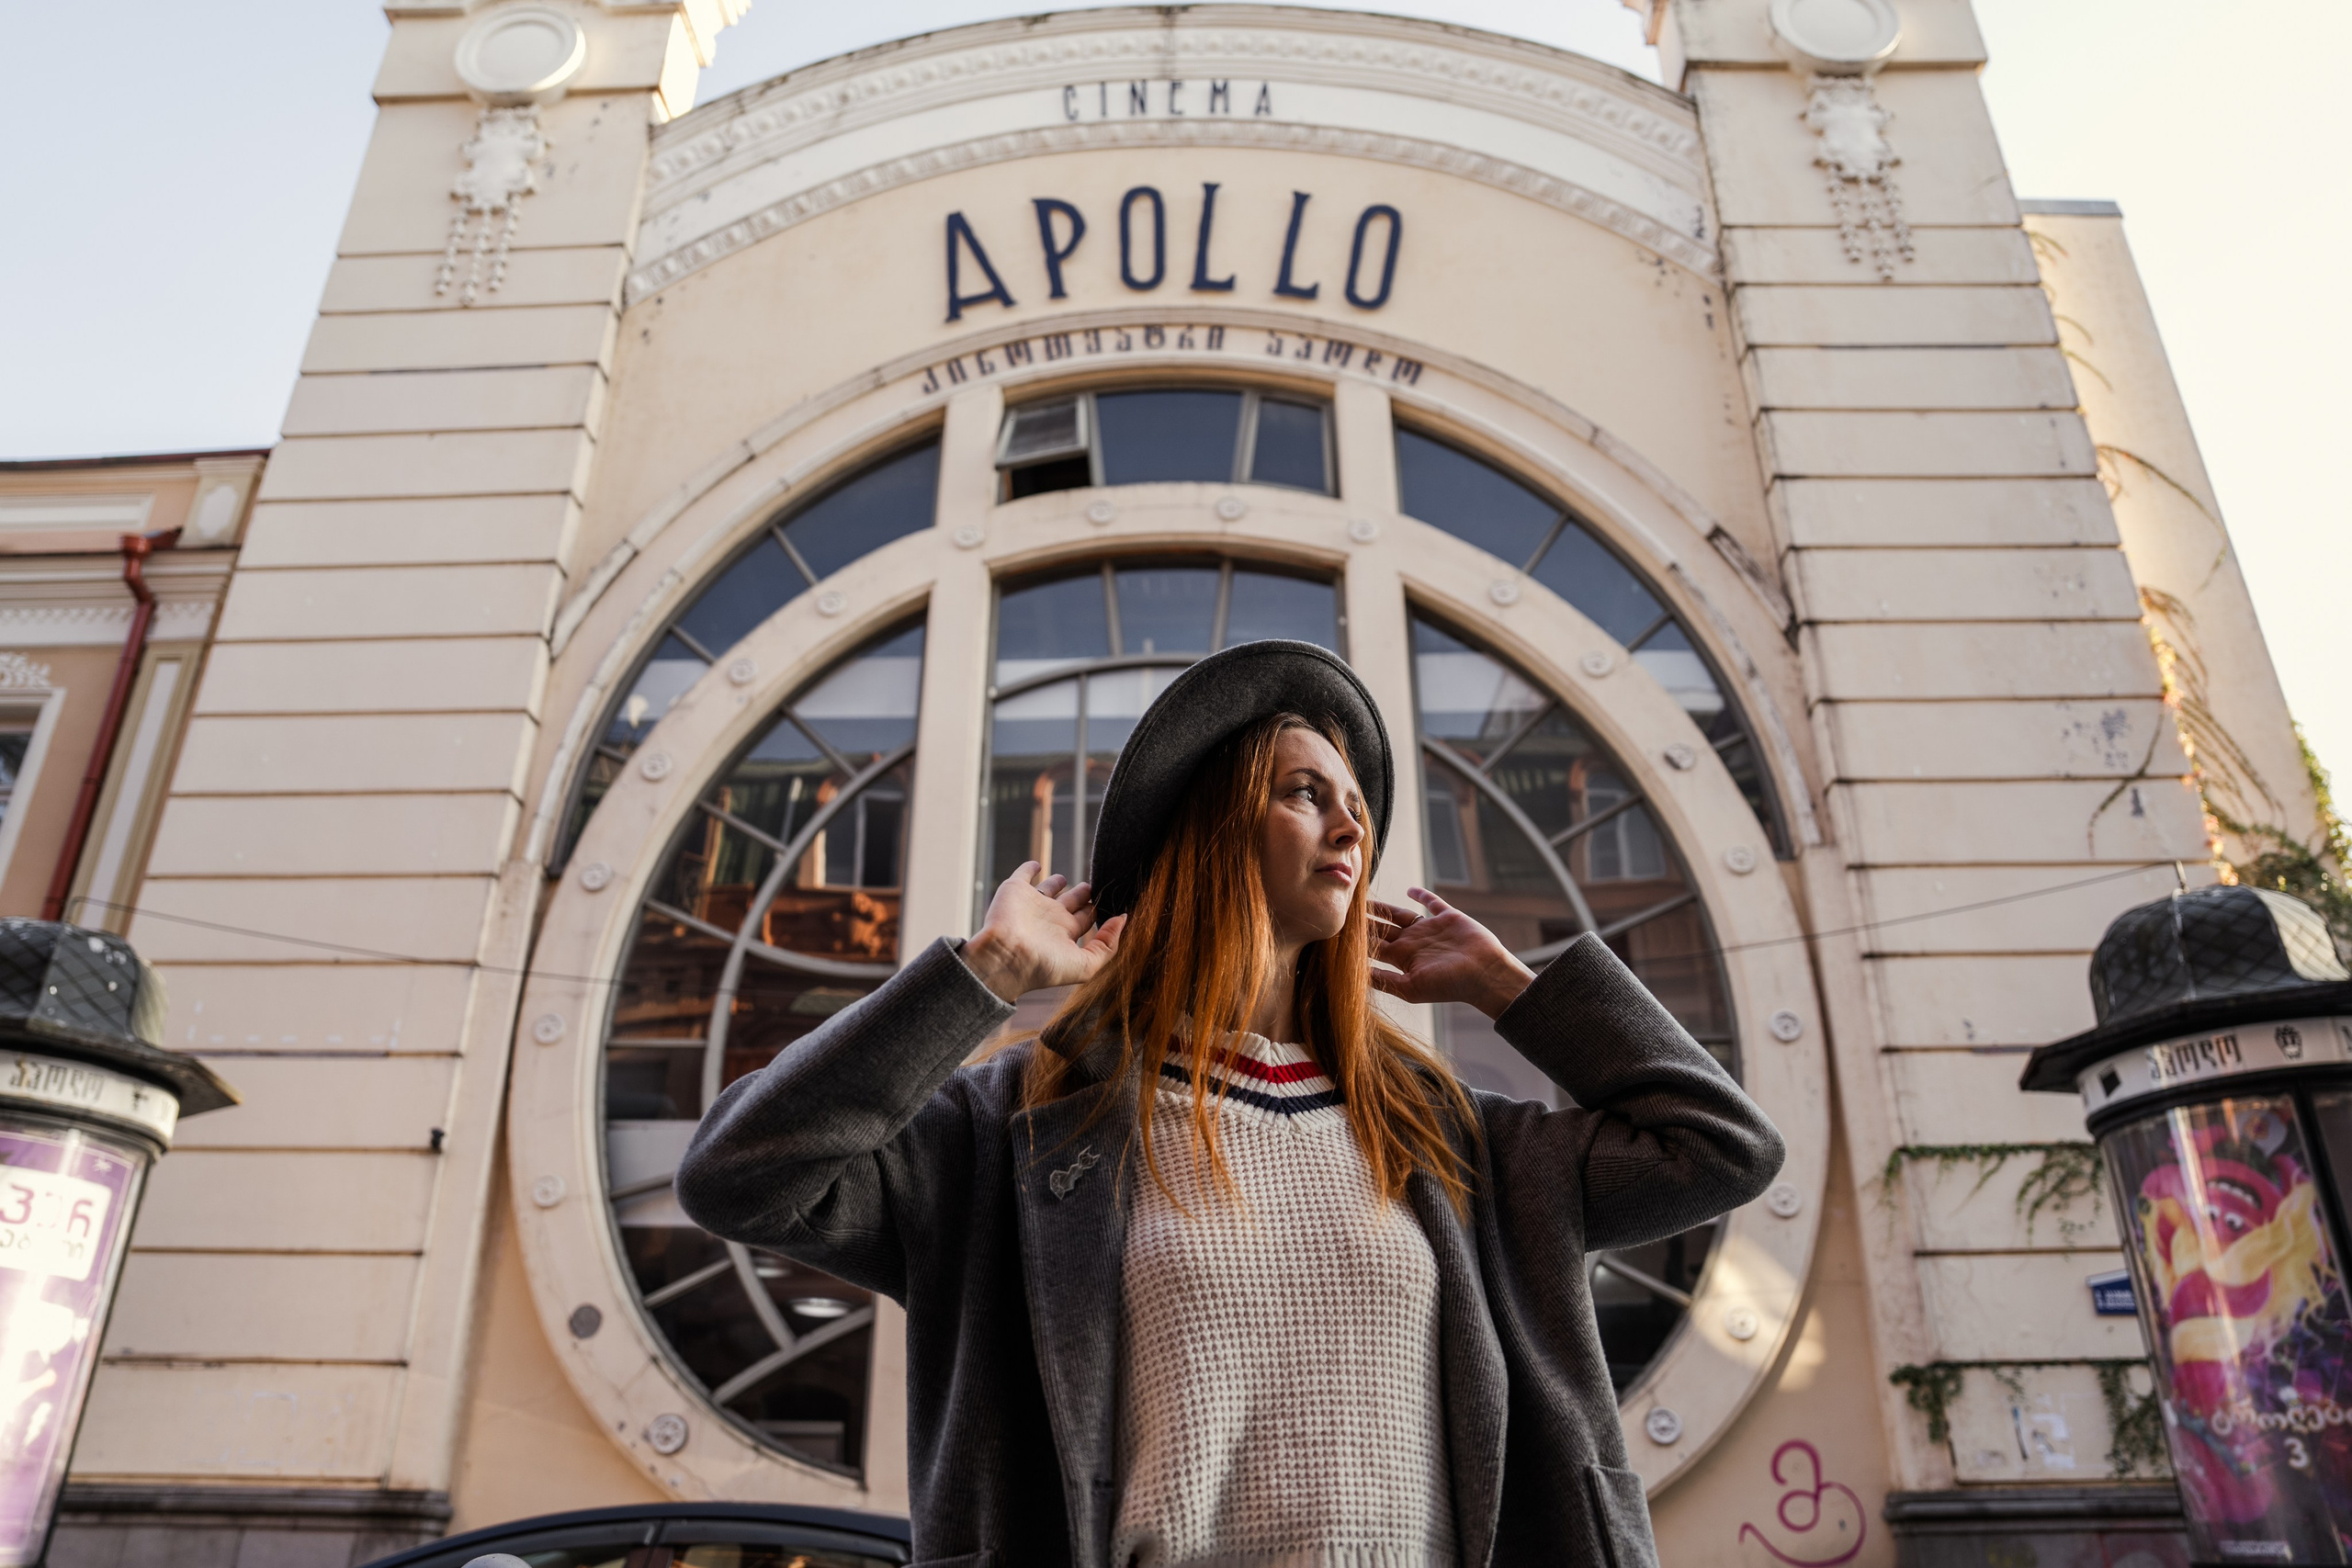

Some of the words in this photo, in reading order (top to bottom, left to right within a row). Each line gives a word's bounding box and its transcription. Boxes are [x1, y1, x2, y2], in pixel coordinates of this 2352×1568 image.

[1062, 79, 1273, 122] CINEMA
[945, 182, 1403, 323] APOLLO
[1266, 329, 1425, 387] აპოლო
